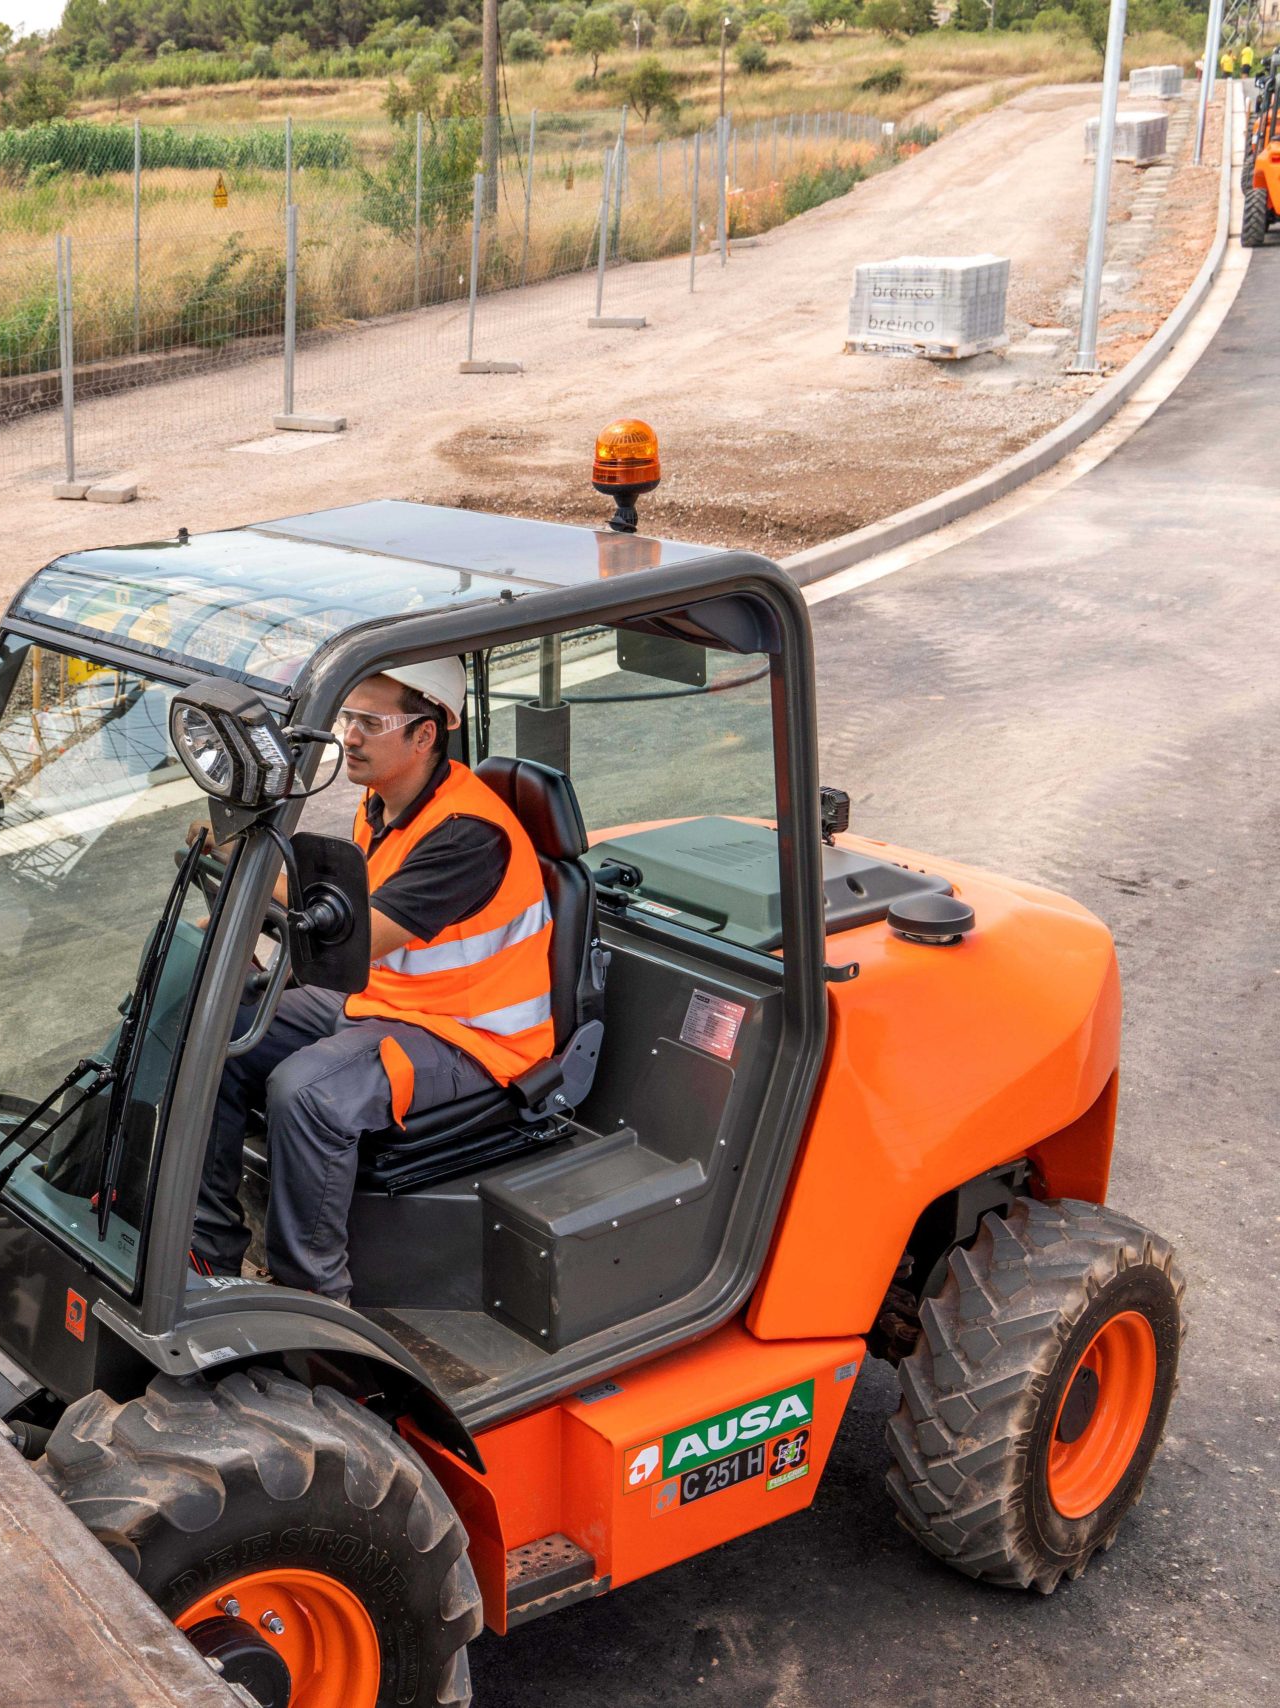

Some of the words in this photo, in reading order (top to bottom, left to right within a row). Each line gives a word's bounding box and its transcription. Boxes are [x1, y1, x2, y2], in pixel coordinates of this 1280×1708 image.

[873, 283, 934, 299] breinco
[868, 314, 934, 332] breinco
[668, 1394, 808, 1468] AUSA
[682, 1473, 699, 1500] C
[704, 1457, 740, 1494] 251
[746, 1447, 763, 1476] H
[169, 1526, 408, 1604] DEESTONE
